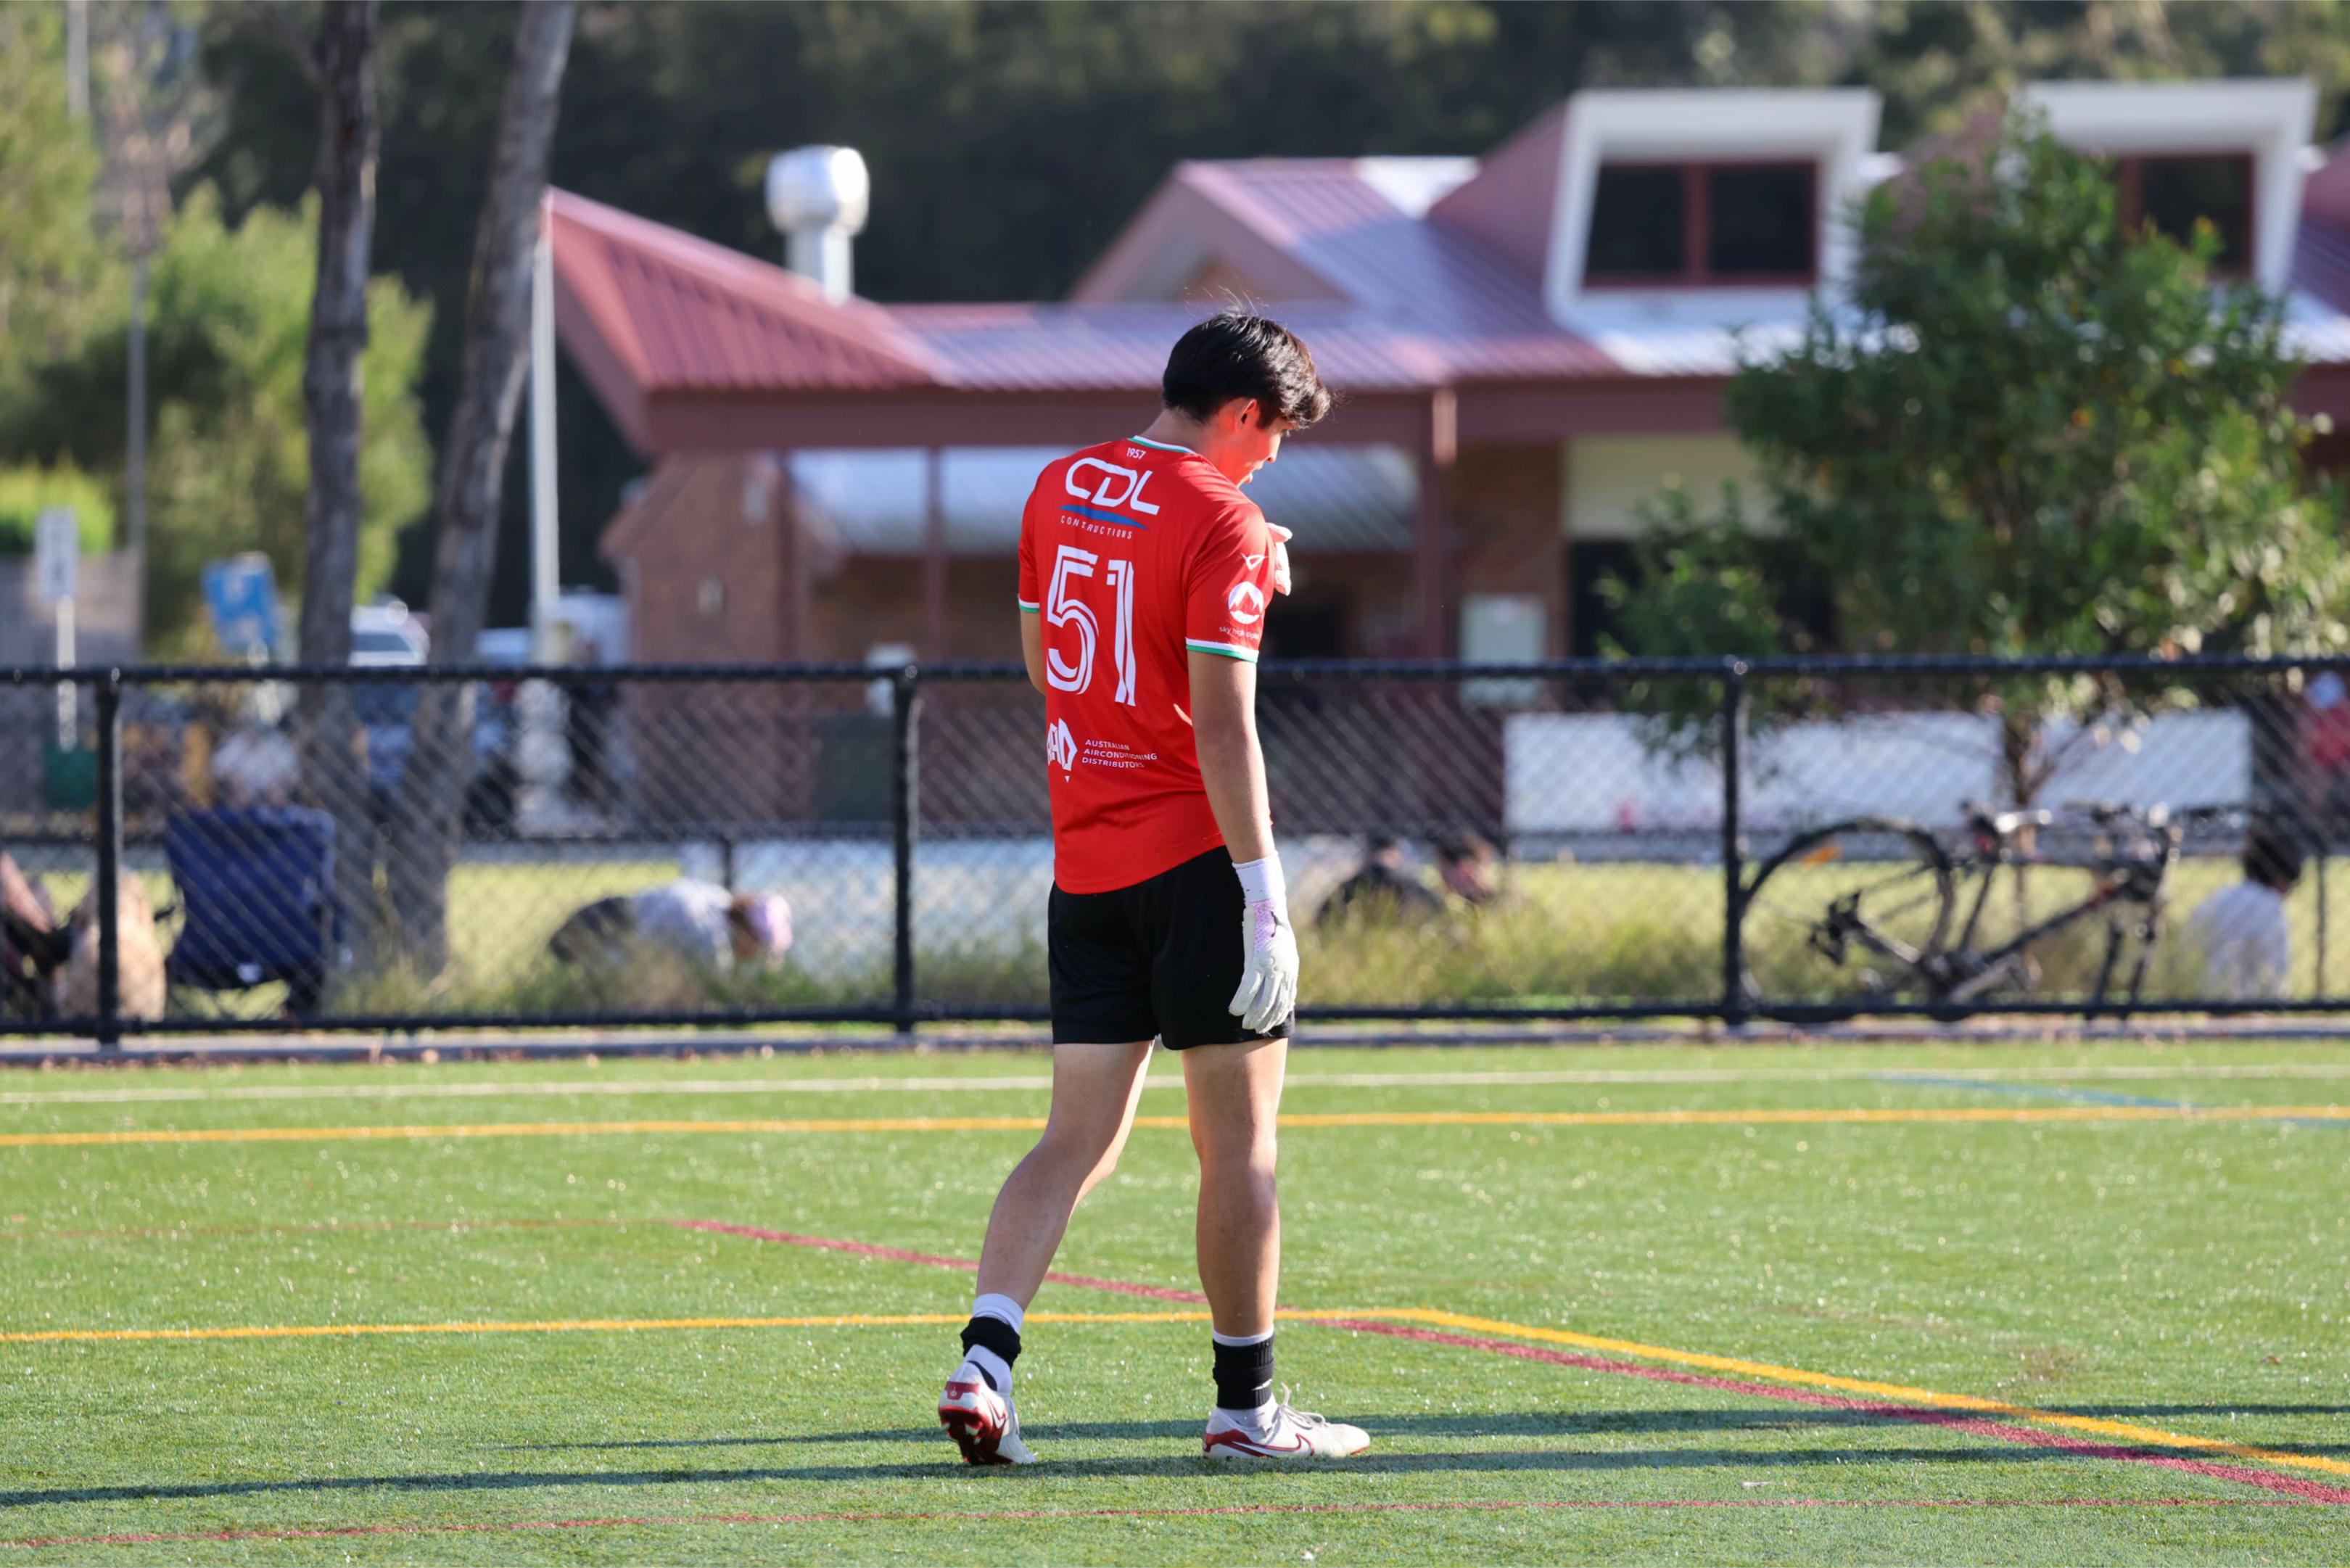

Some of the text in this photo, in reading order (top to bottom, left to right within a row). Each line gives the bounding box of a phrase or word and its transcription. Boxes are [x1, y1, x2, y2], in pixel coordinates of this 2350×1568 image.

[1126, 447, 1147, 460] 1957
[1065, 457, 1160, 516] CDL
[1047, 545, 1137, 707] 51
[1084, 739, 1130, 751] AUSTRALIAN
[1084, 748, 1158, 761] AIRCONDITIONING
[1081, 757, 1145, 769] DISTRIBUTORS
